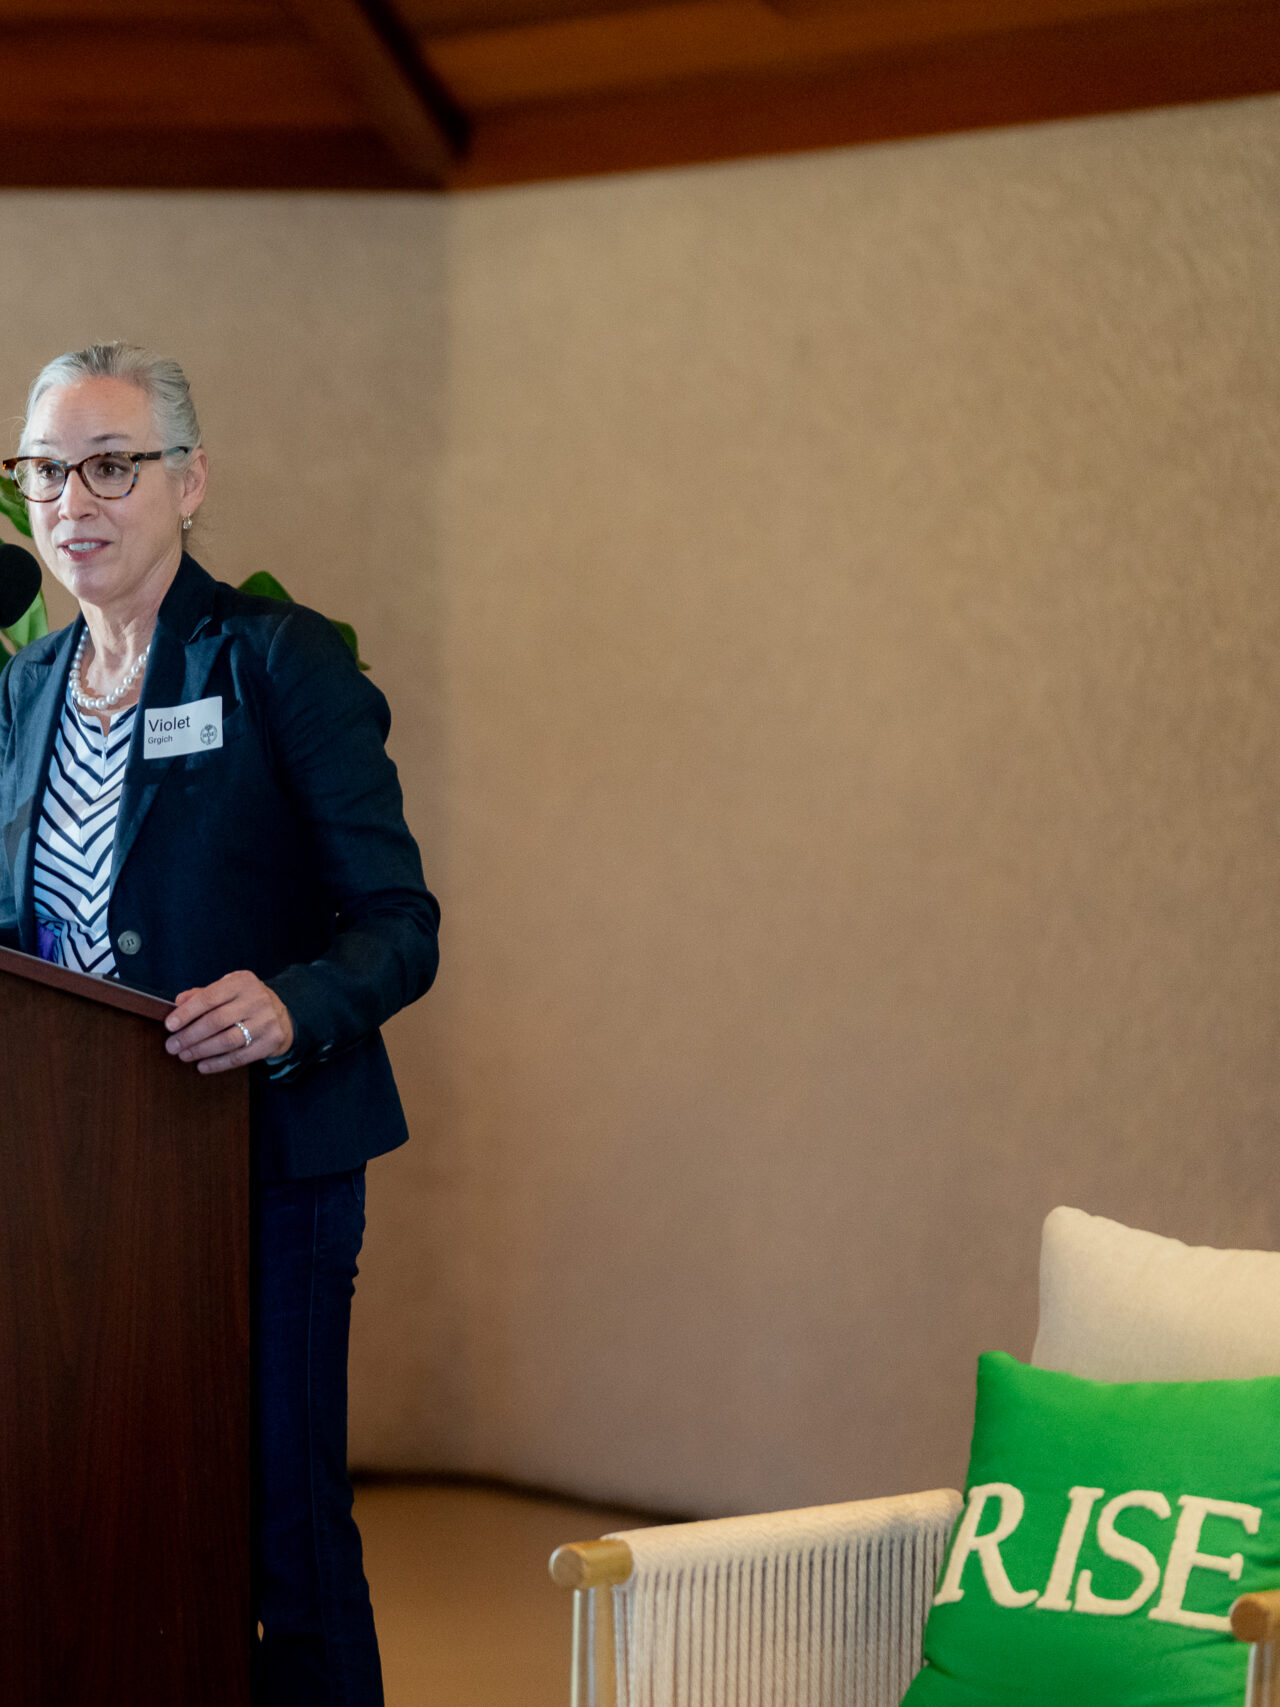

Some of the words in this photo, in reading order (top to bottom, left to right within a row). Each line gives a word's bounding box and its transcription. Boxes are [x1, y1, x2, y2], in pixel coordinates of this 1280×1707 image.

[148, 716, 191, 732] Violet
[148, 735, 173, 745] Grgich
[933, 1482, 1262, 1632] RISE
